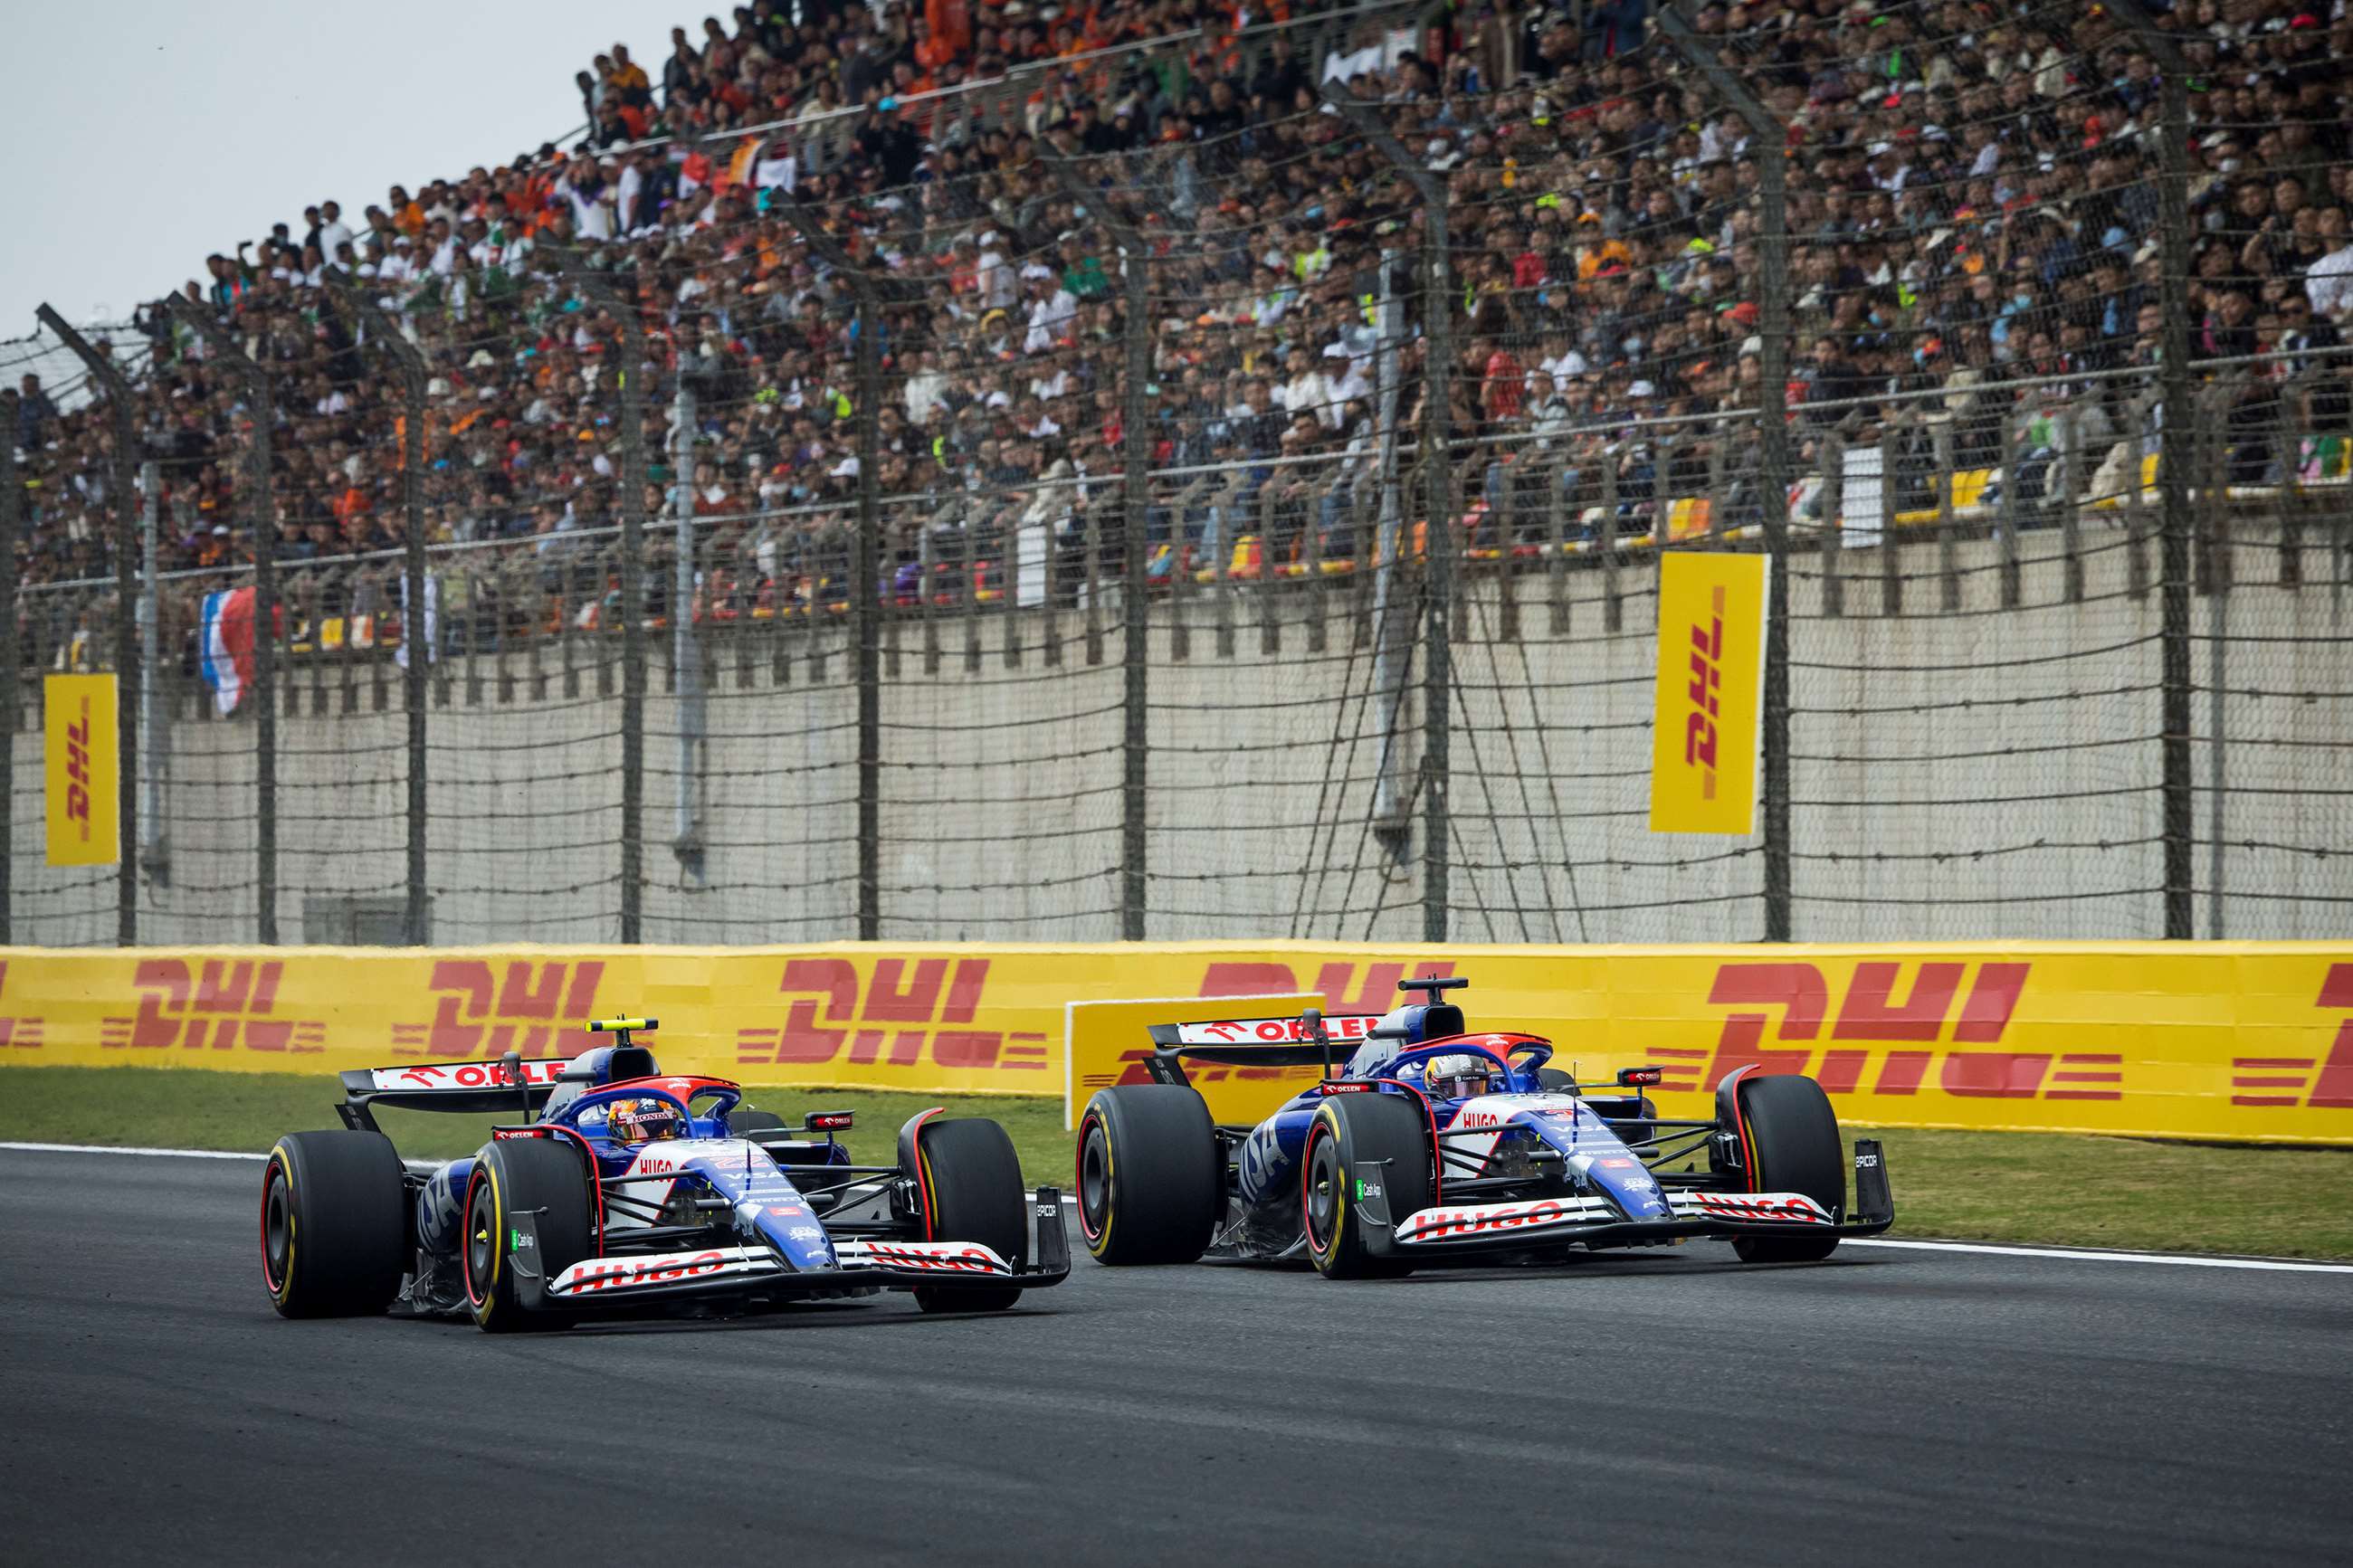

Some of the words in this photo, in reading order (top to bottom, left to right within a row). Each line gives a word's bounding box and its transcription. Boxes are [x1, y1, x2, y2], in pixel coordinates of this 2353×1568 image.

[1685, 614, 1724, 770] DHL
[67, 717, 89, 822] DHL
[131, 959, 294, 1052] DHL
[426, 960, 618, 1059] DHL
[776, 957, 1003, 1069] DHL
[1704, 962, 2053, 1100] DHL
[454, 1062, 566, 1087] ORLE
[509, 1131, 534, 1139] ORLEN
[633, 1112, 669, 1123] HONDA
[1463, 1113, 1498, 1136] HUGO
[640, 1159, 672, 1183] HUGO
[1363, 1183, 1372, 1195] Cash
[1415, 1201, 1564, 1240] HUGO
[1695, 1193, 1817, 1221] HUGO
[571, 1251, 725, 1294] HUGO
[866, 1242, 994, 1273] HUGO
